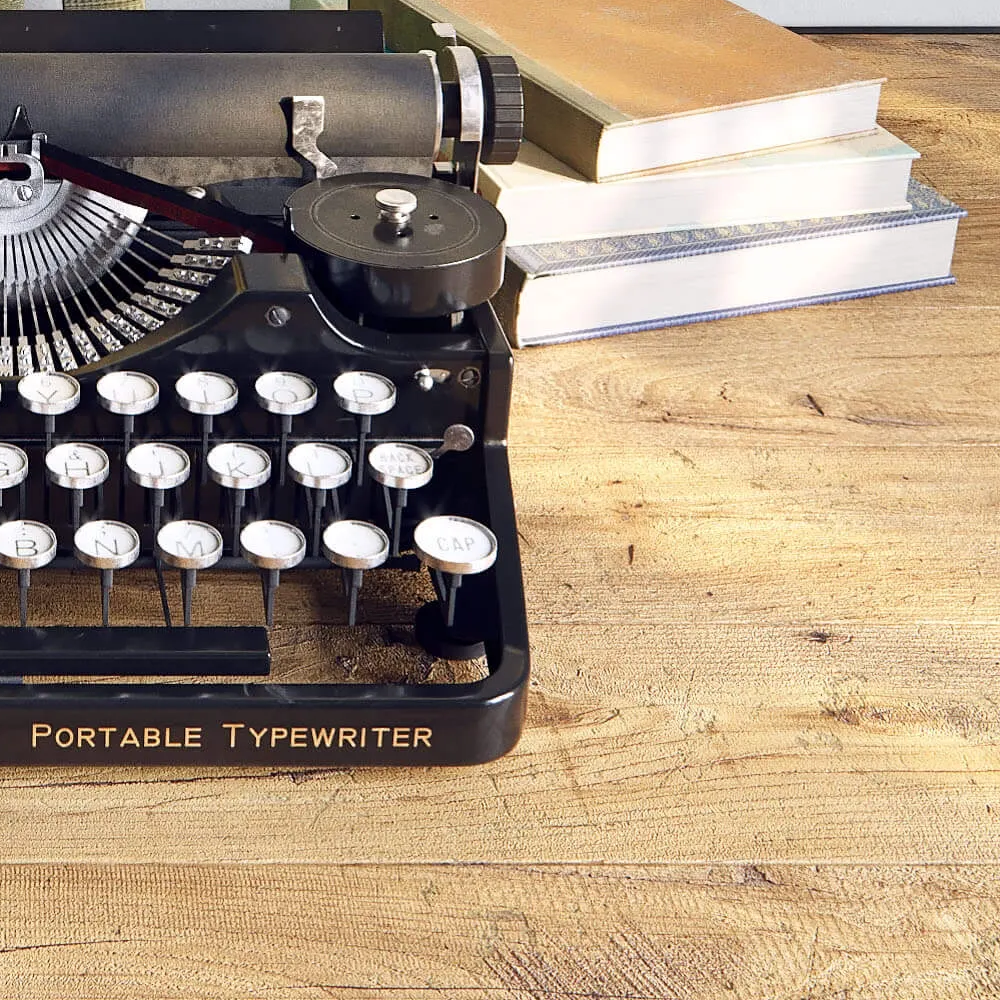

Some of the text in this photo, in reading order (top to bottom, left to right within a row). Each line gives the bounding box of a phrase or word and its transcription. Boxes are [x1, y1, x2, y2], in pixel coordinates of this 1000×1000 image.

[352, 388, 374, 403] P
[65, 461, 90, 477] H
[226, 462, 250, 478] K
[15, 539, 38, 557] B
[94, 539, 119, 557] N
[175, 541, 204, 557] M
[436, 536, 476, 552] CAP
[32, 723, 202, 748] PORTABLE
[222, 723, 433, 748] TYPEWRITER
